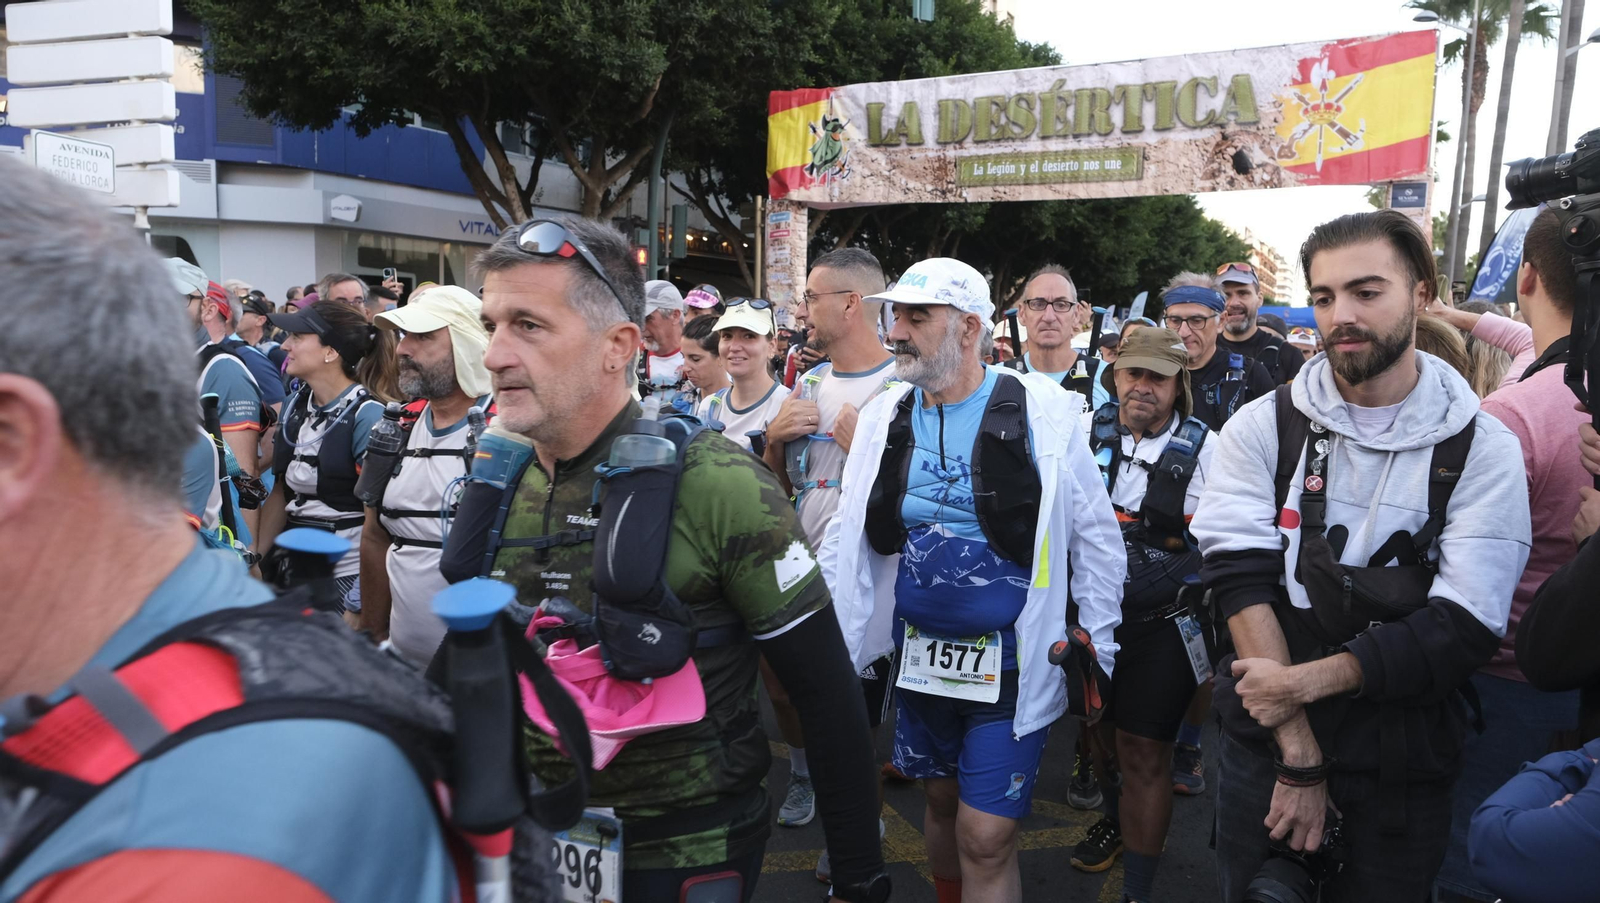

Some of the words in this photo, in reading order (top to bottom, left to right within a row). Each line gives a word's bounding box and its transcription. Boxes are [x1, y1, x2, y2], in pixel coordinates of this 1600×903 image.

[865, 101, 925, 146] LA
[937, 73, 1261, 144] DESÉRTICA
[59, 143, 110, 159] AVENIDA
[52, 154, 98, 174] FEDERICO
[973, 163, 984, 176] La
[987, 161, 1016, 178] Legión
[1020, 164, 1026, 176] y
[1030, 160, 1039, 173] el
[1042, 158, 1079, 173] desierto
[1083, 160, 1100, 171] nos
[1104, 159, 1122, 170] une
[80, 174, 109, 189] LORCA
[926, 640, 986, 673] 1577
[901, 675, 923, 685] asisa
[960, 672, 984, 680] ANTONIO
